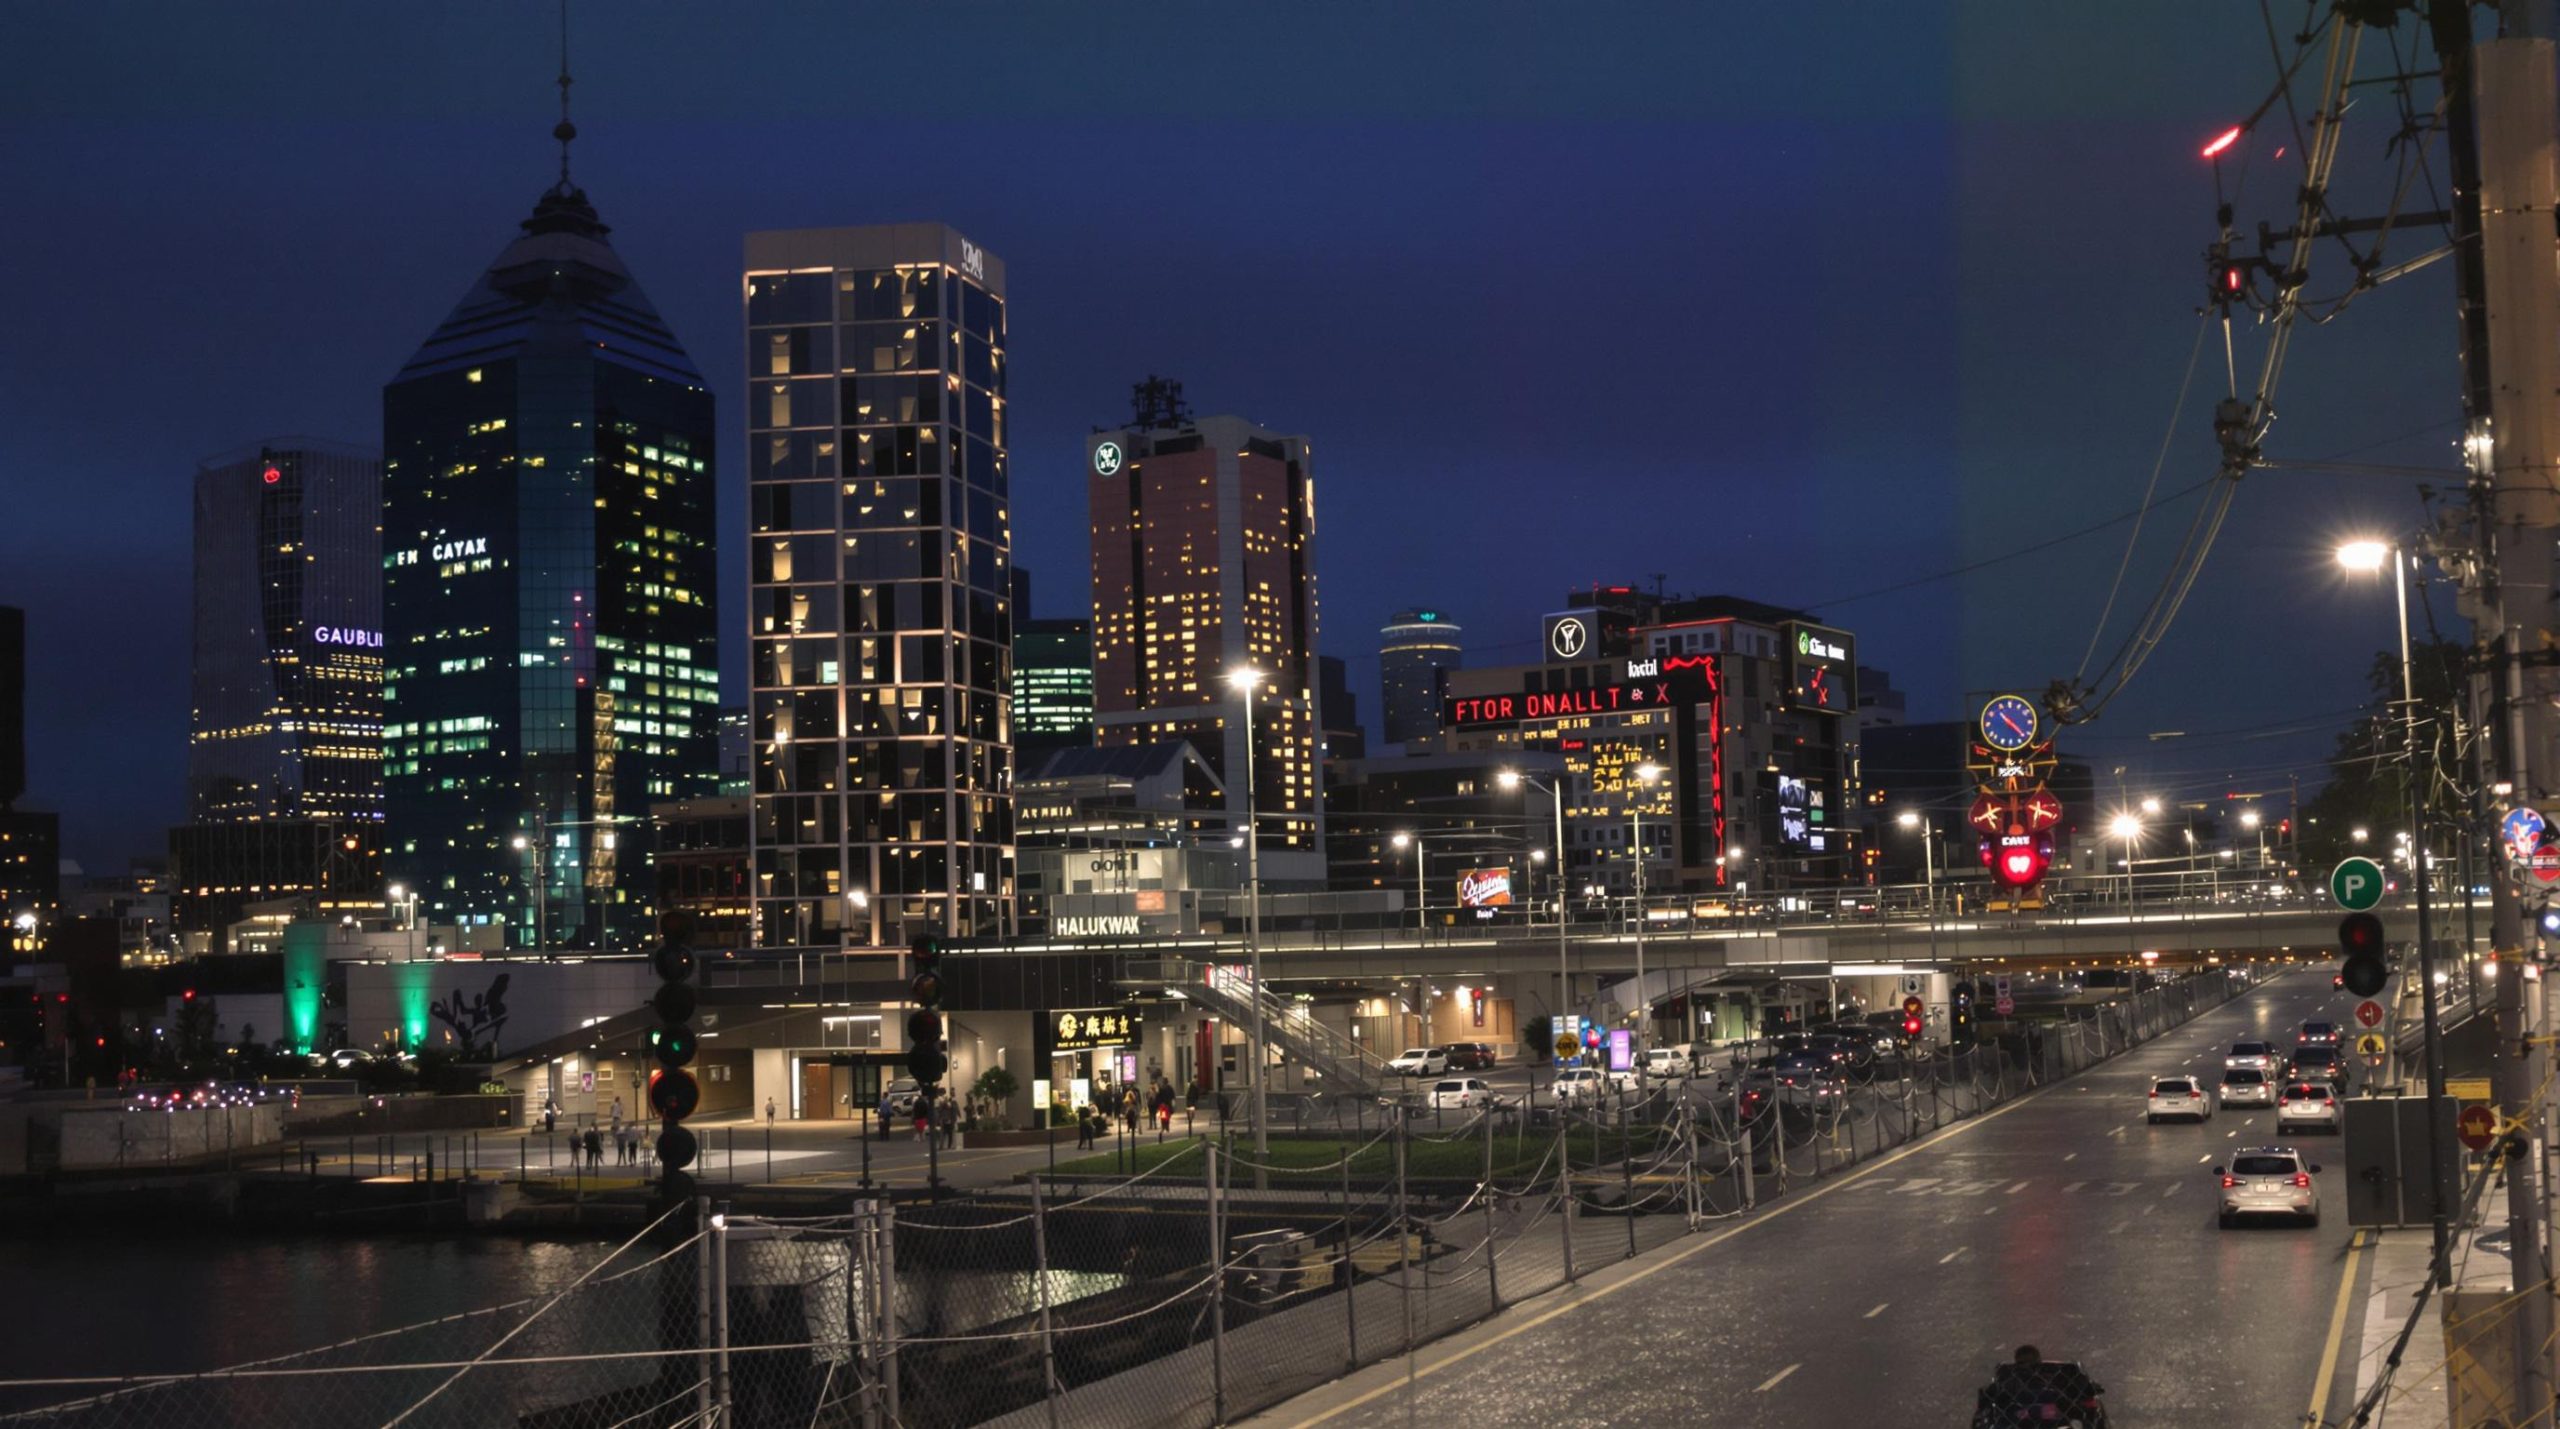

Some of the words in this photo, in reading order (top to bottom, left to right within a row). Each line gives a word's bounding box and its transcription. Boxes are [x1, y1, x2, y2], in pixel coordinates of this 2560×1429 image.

[432, 537, 486, 561] CAYAX
[1456, 697, 1513, 721] FTOR
[2345, 875, 2365, 900] P
[1057, 915, 1140, 936] HALUKWAX
